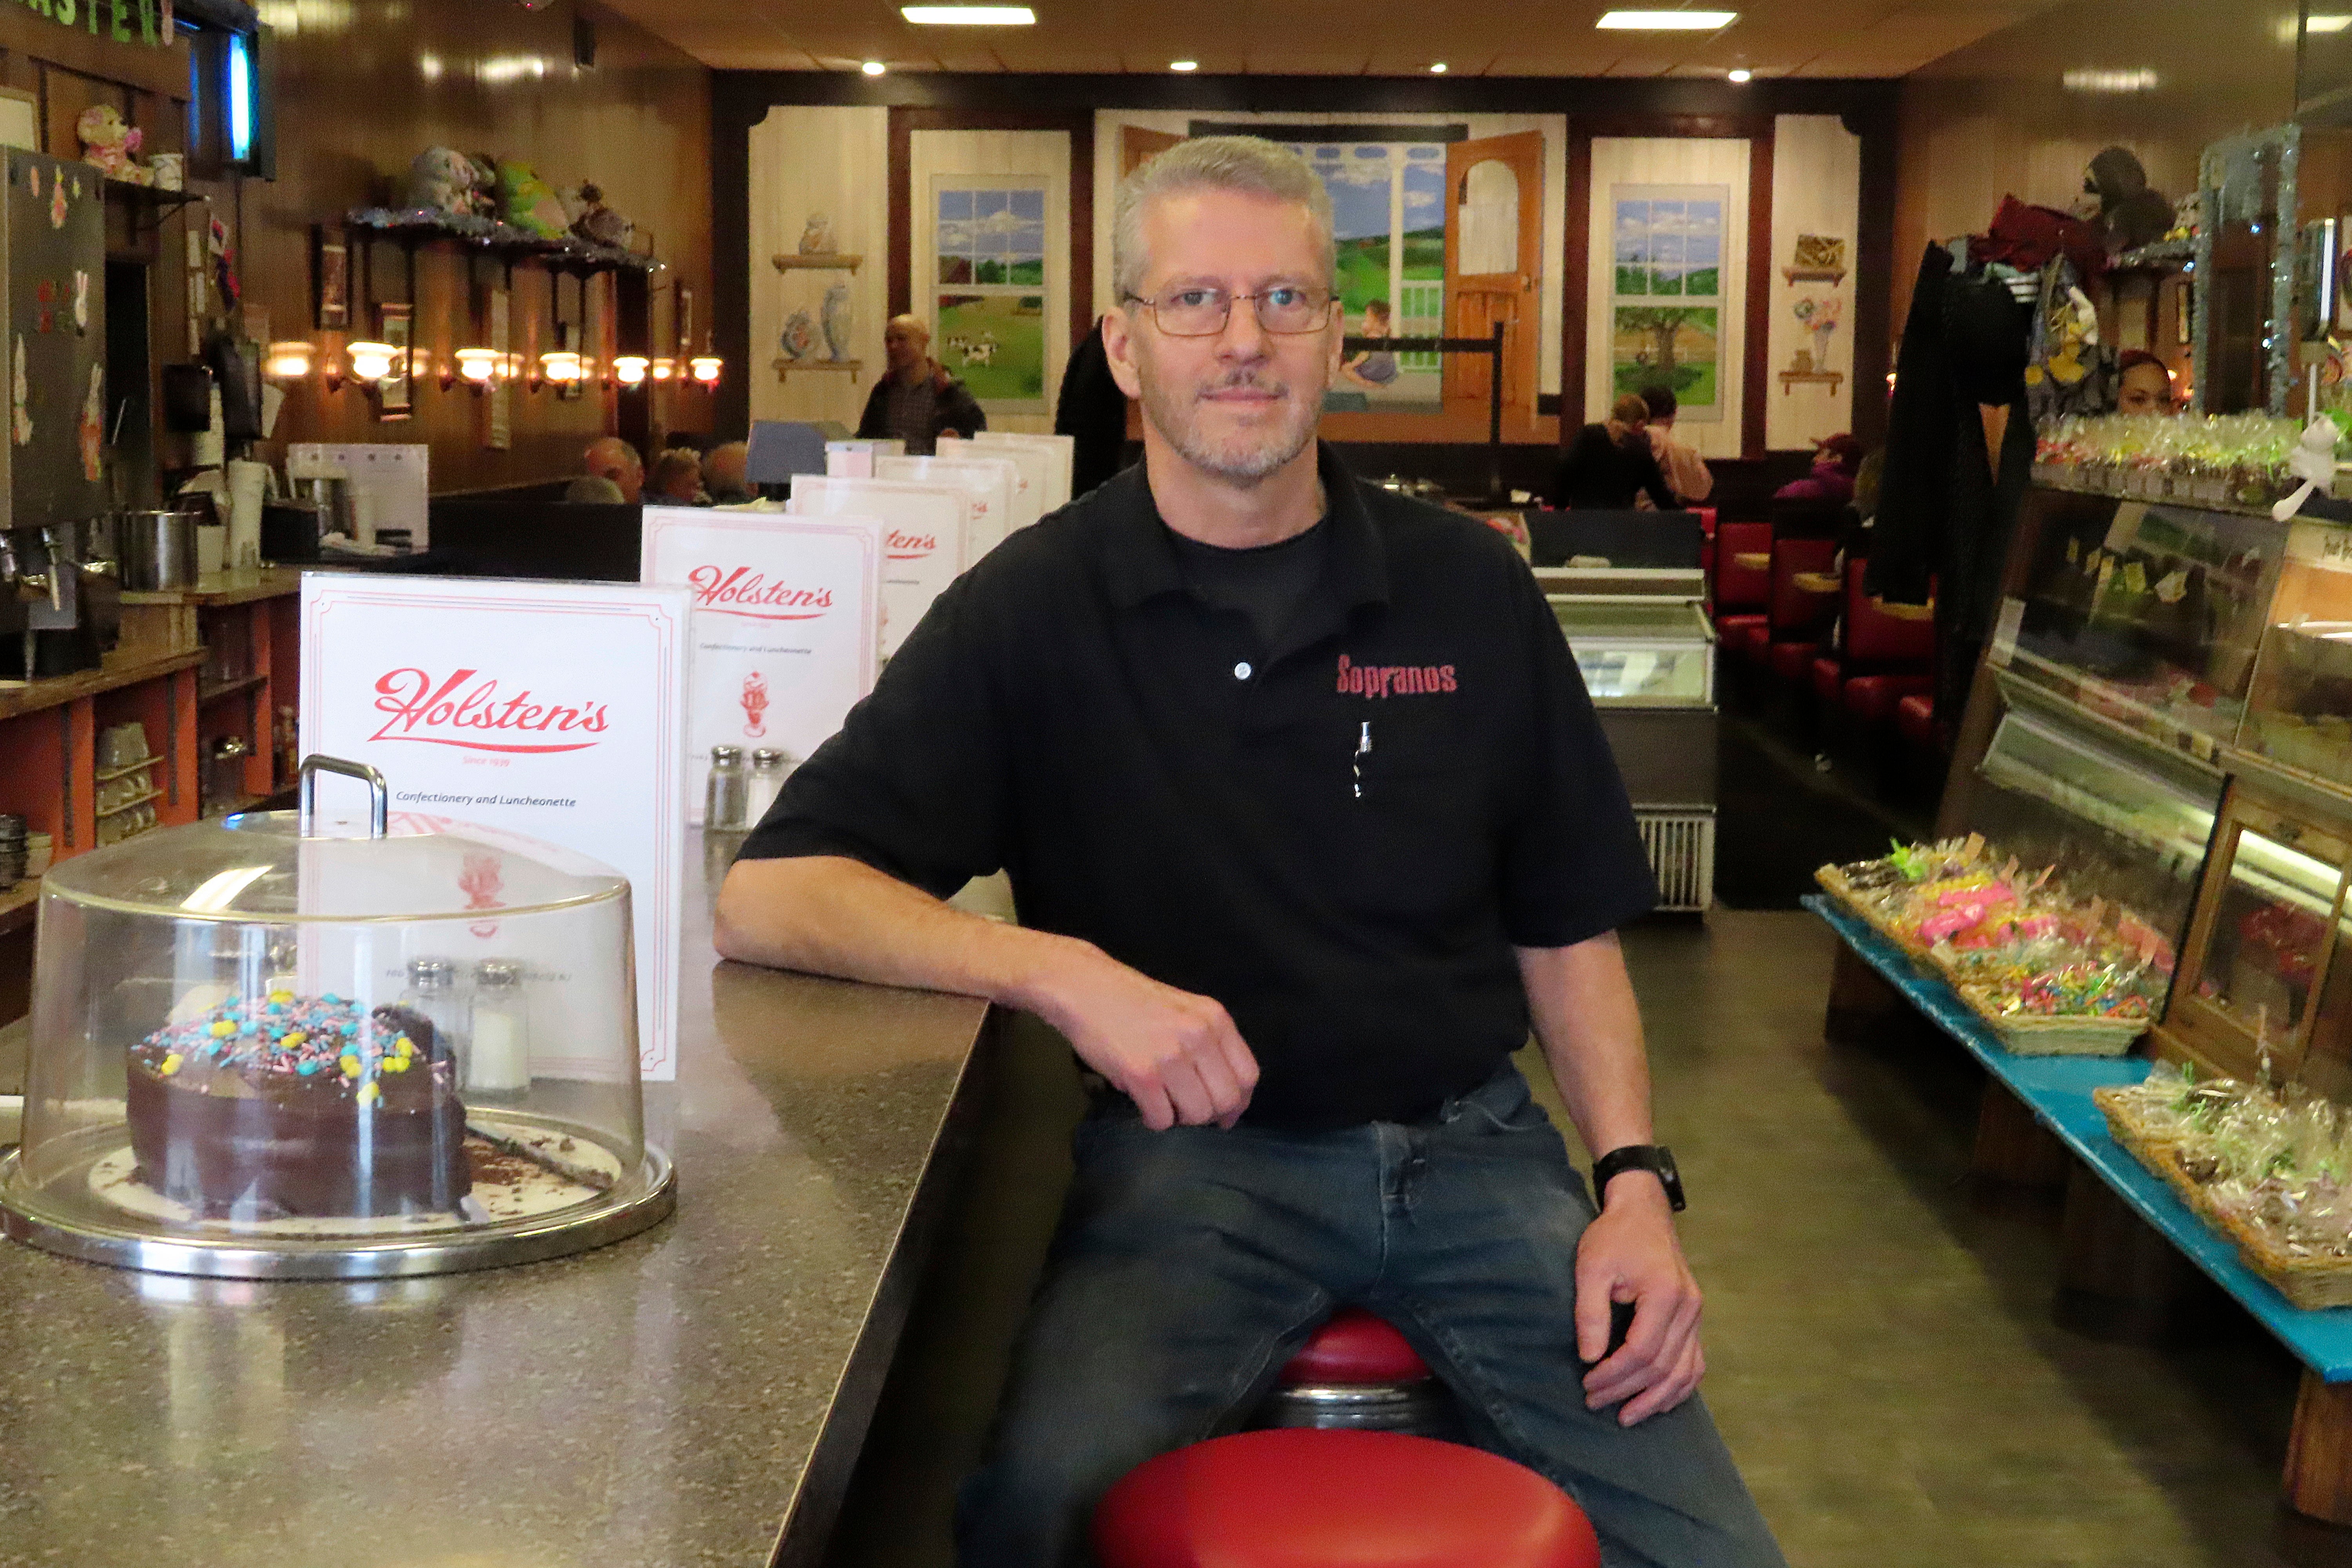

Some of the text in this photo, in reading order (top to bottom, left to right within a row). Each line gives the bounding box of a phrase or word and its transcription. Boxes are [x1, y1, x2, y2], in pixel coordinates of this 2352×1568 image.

[688, 565, 833, 620] Holsten's
[1336, 654, 1457, 699] Sopranos
[367, 667, 609, 753] Holsten's
[463, 756, 487, 765] Since
[396, 791, 577, 807] Confectionery and Luncheonette
